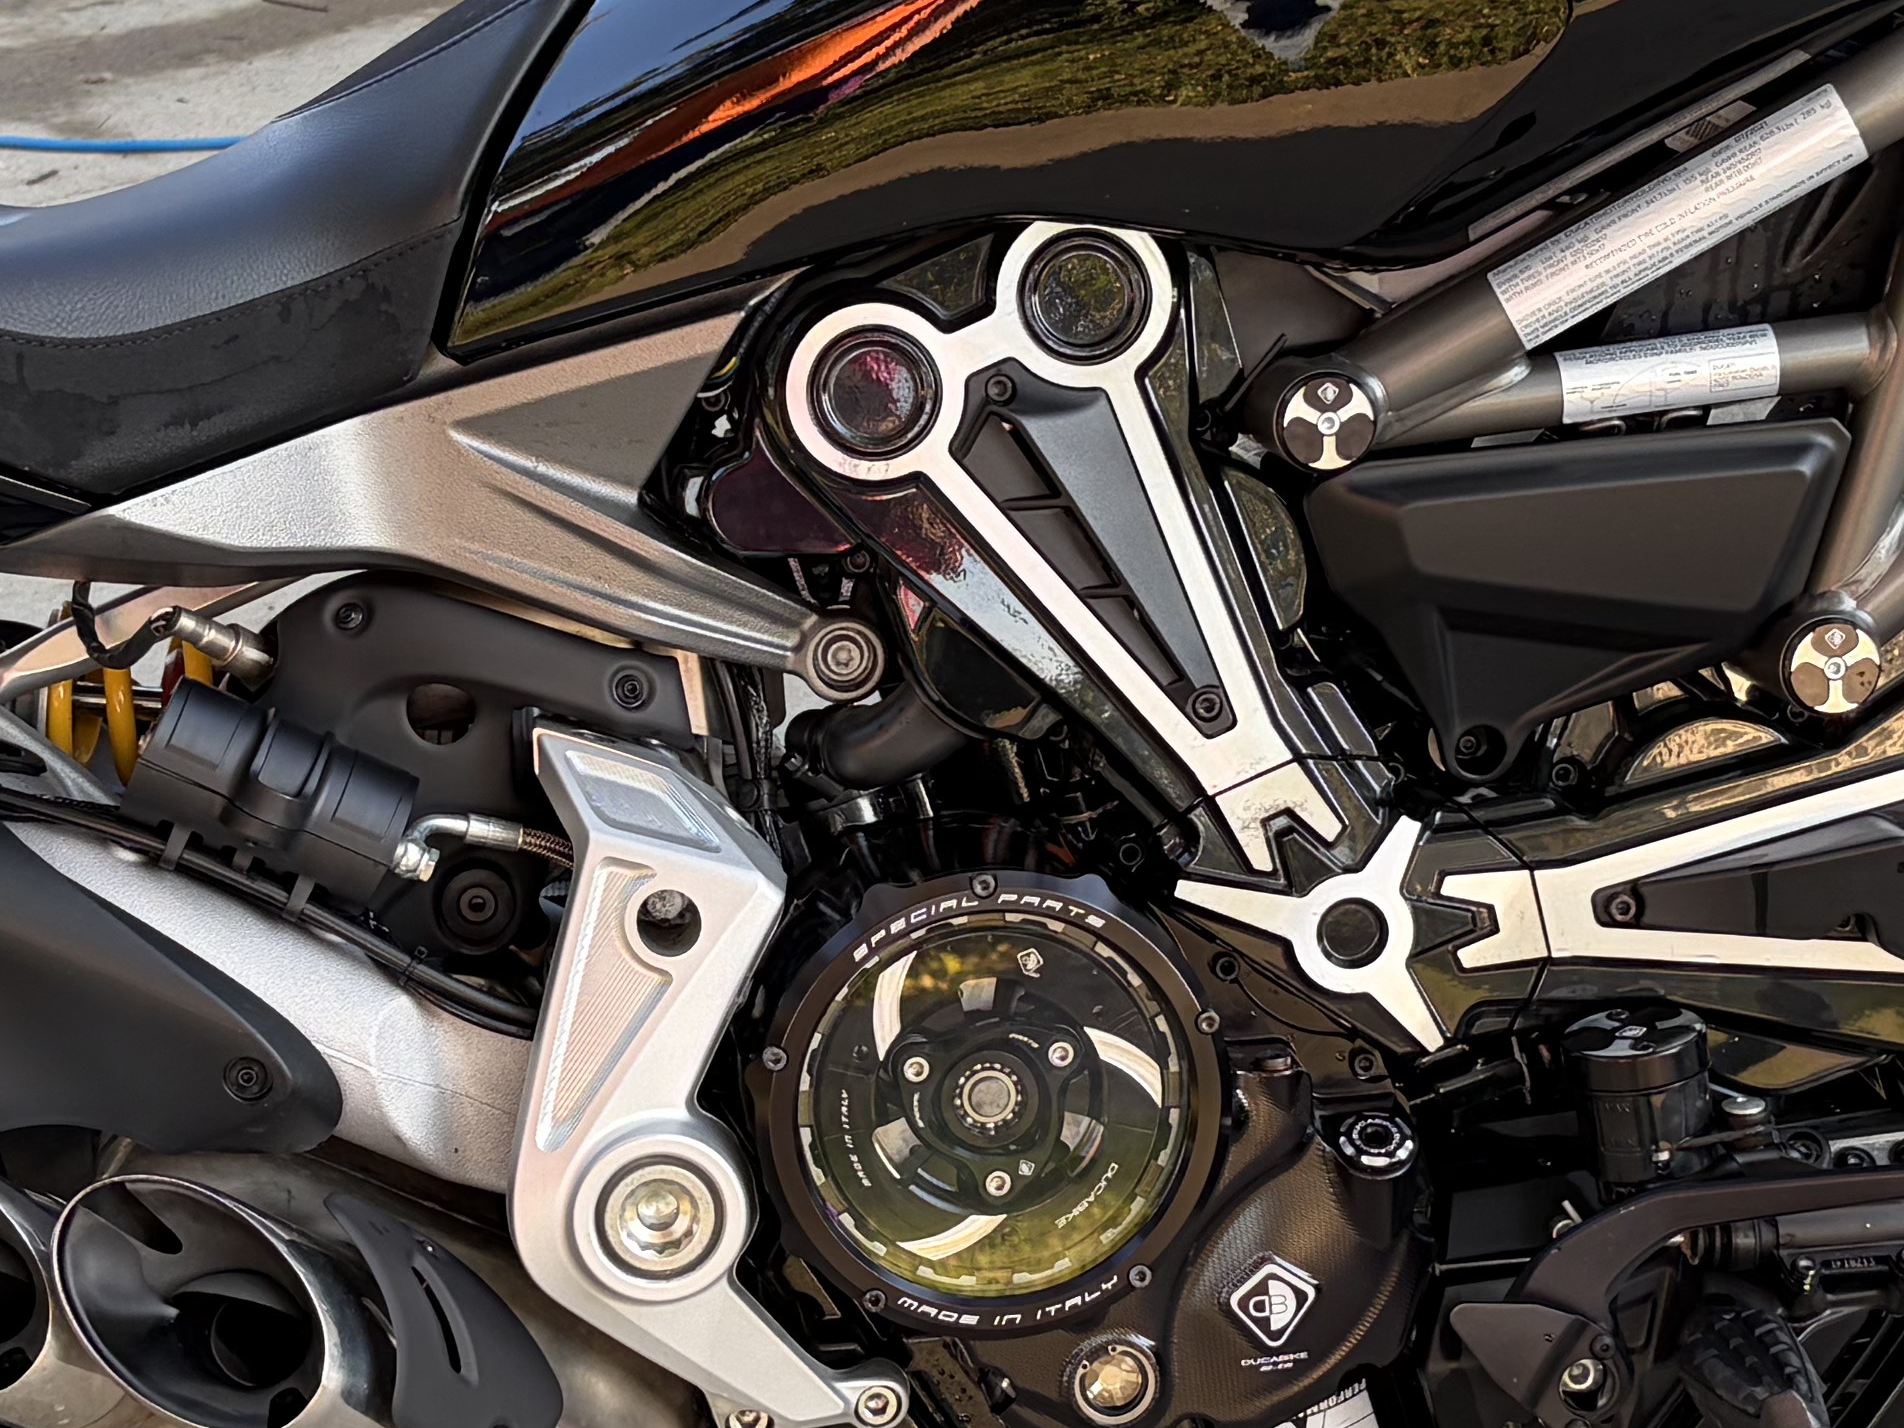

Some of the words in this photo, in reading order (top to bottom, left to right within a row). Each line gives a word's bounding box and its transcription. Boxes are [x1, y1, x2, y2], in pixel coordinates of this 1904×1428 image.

[852, 895, 979, 963] SPECIAL
[997, 893, 1106, 928] PARTS
[1053, 1161, 1121, 1230] DUCABIKE
[896, 1295, 980, 1326] MADE
[993, 1312, 1022, 1327] IN
[1035, 1274, 1119, 1321] ITALY
